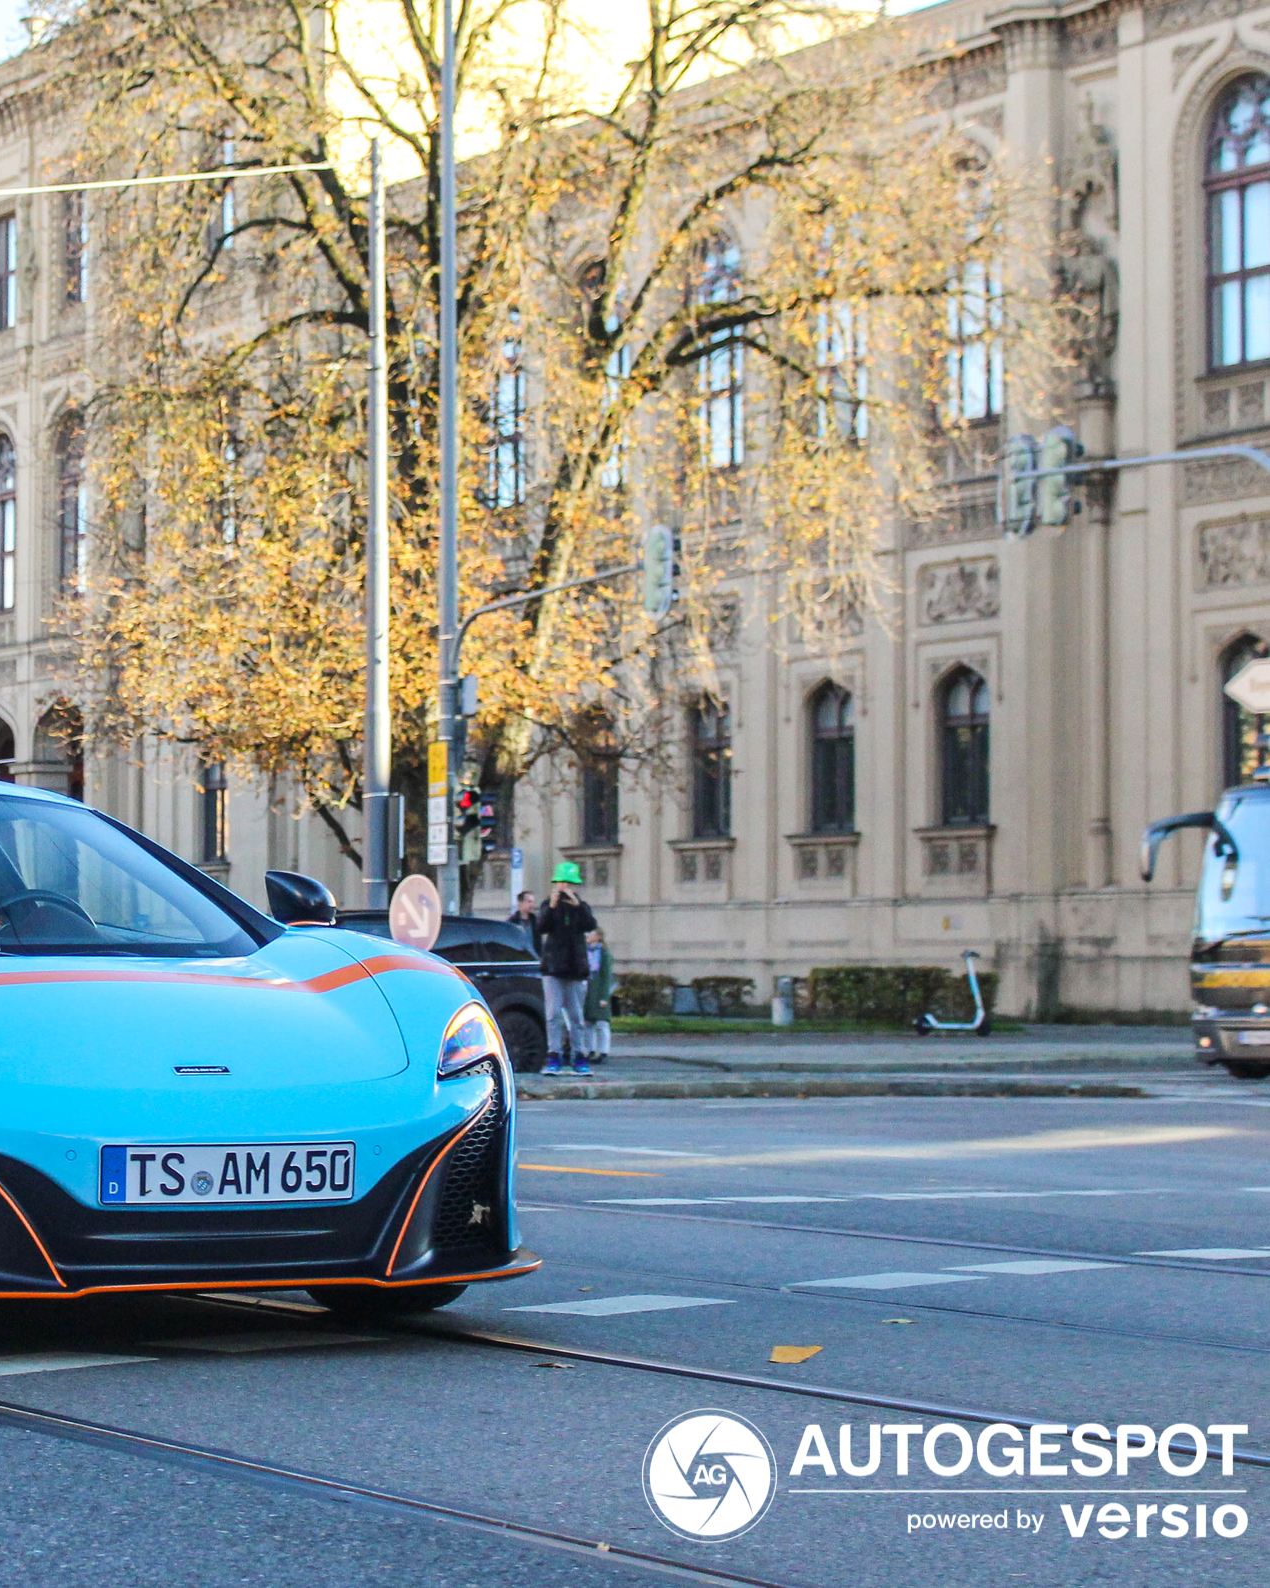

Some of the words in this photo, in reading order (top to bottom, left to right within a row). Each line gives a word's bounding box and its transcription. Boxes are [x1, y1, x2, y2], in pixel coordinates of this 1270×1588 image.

[108, 1182, 119, 1195] D
[130, 1152, 185, 1196] TS
[218, 1151, 270, 1195] AM
[281, 1149, 350, 1193] 650
